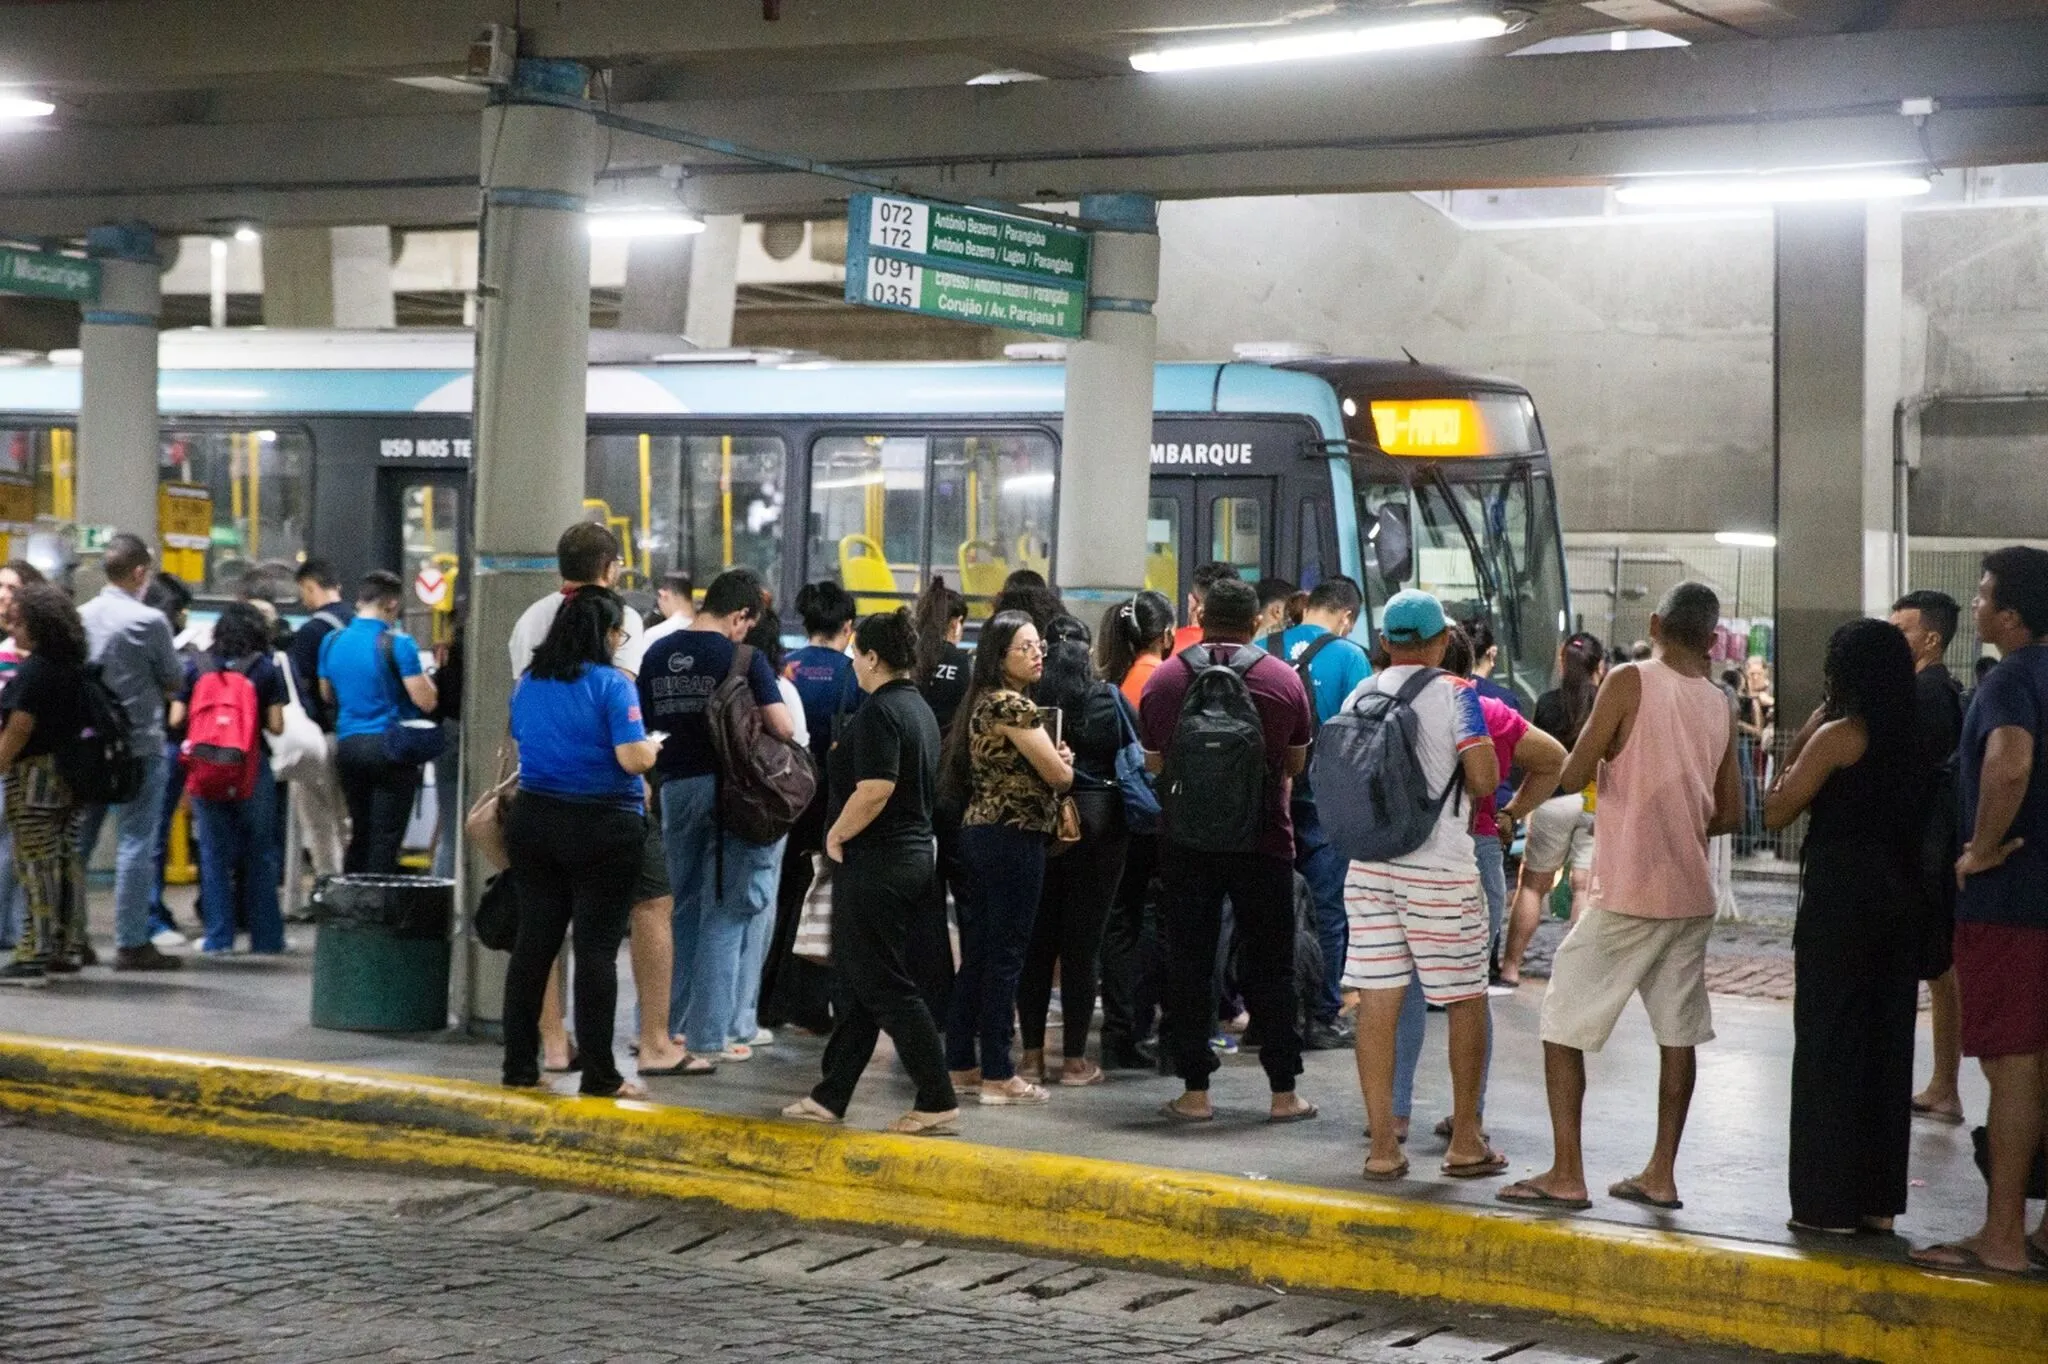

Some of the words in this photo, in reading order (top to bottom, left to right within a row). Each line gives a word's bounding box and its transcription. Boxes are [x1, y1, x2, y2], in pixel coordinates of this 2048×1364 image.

[880, 203, 913, 226] 072
[880, 226, 912, 249] 172
[934, 212, 966, 232] Antônio
[967, 217, 998, 237] Bezerra
[1005, 224, 1046, 247] Parangaba
[932, 236, 964, 254] Antônio
[965, 240, 996, 260] Bezerra
[1033, 252, 1074, 274] Parangaba
[874, 257, 914, 281] 091
[872, 283, 912, 307] 035
[938, 294, 983, 316] Corujão
[989, 302, 1007, 319] Av.
[416, 439, 449, 457] NOS
